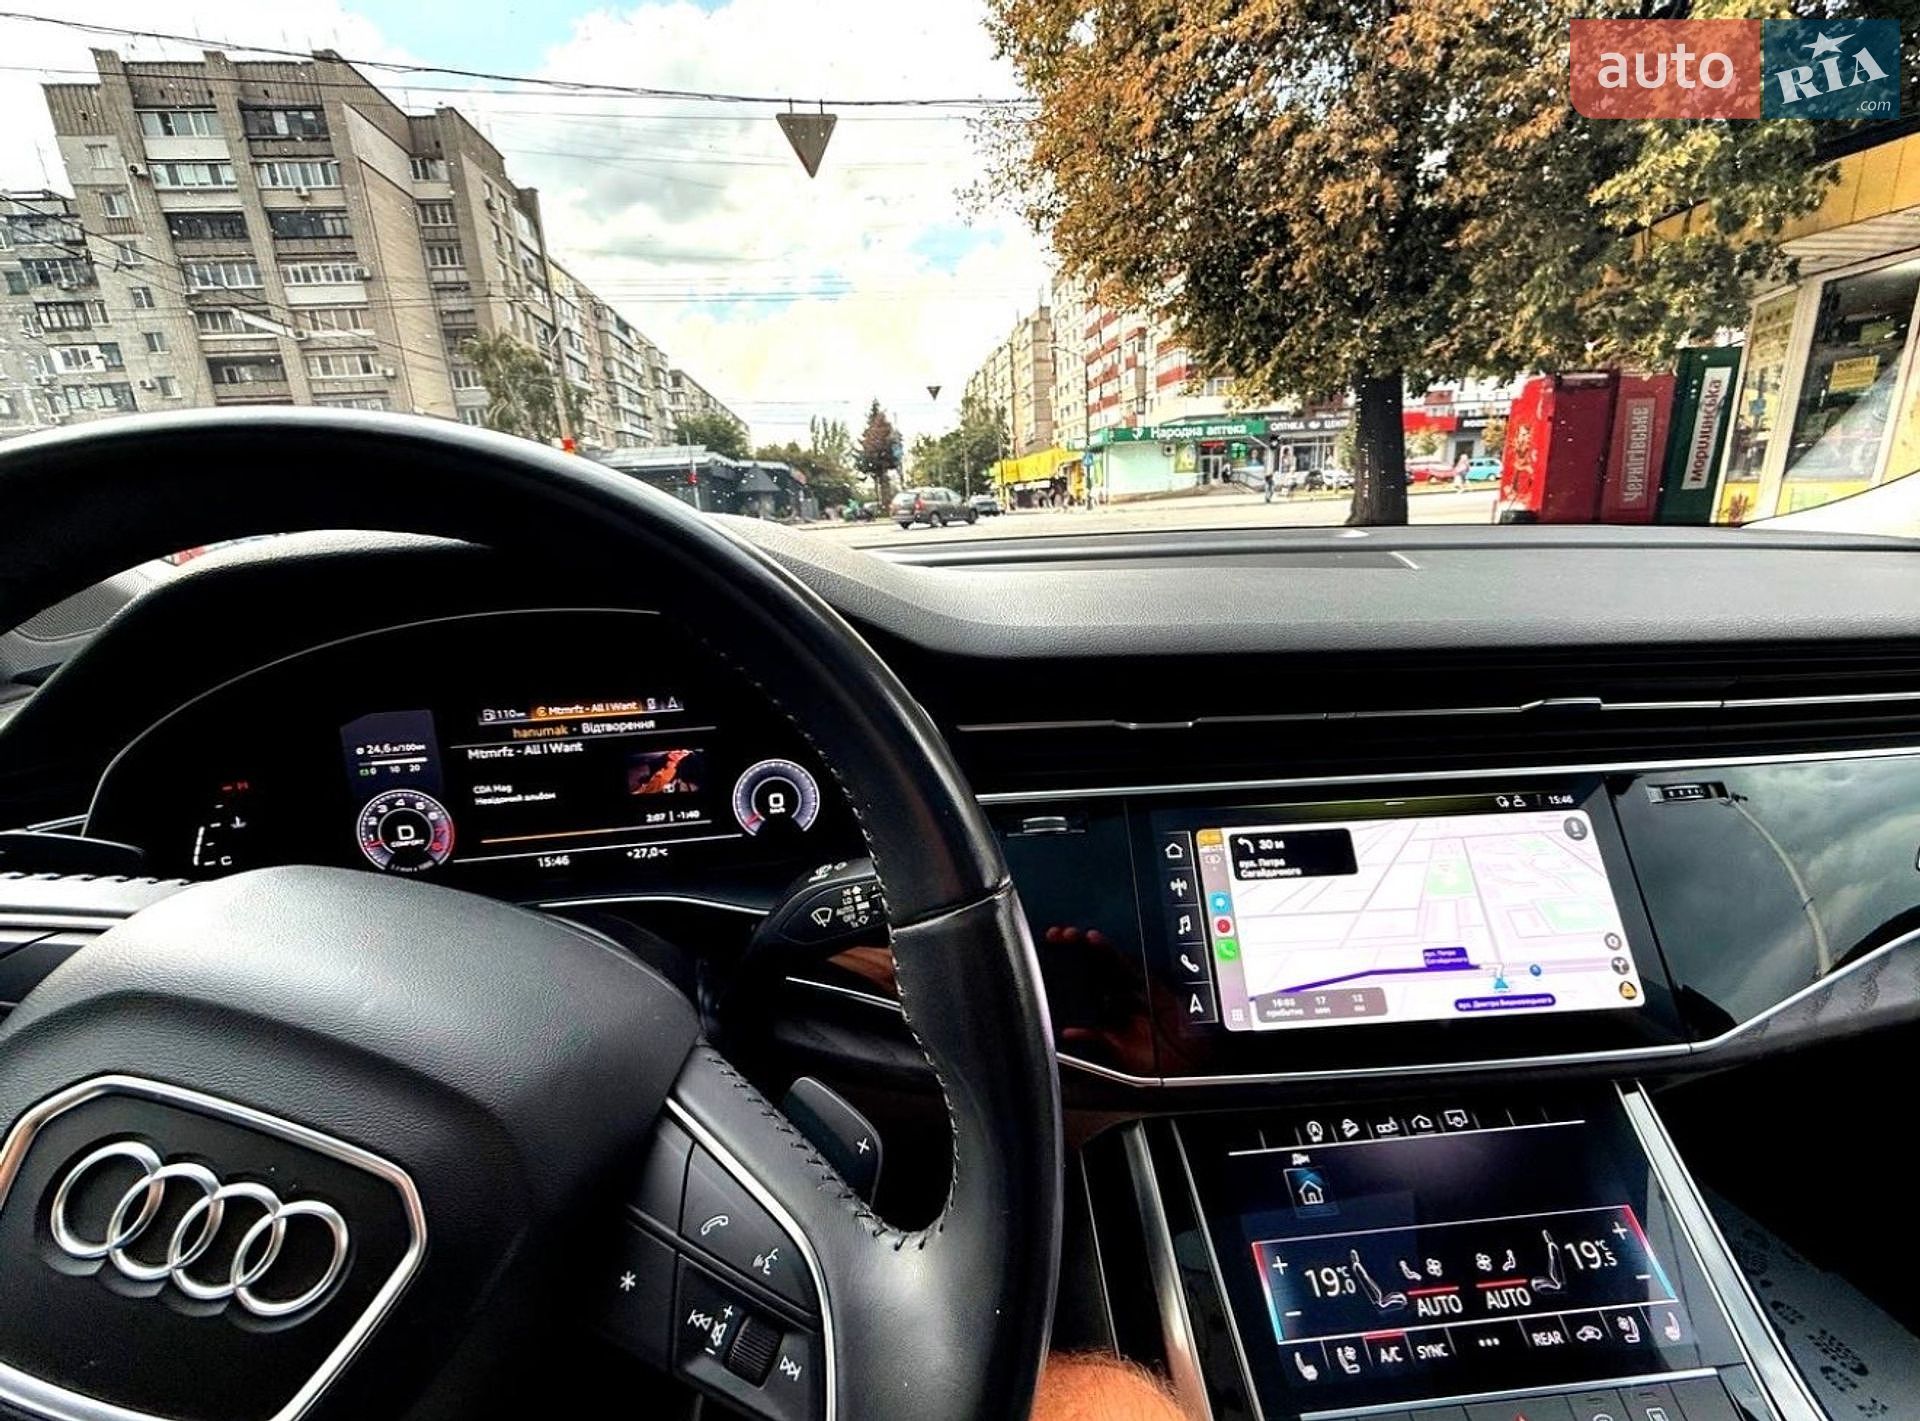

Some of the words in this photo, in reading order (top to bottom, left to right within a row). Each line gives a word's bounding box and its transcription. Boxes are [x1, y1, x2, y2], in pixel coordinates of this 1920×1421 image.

[1150, 427, 1203, 440] Народна
[1206, 424, 1247, 436] аптека
[611, 700, 639, 712] Want
[512, 724, 569, 739] hanumak
[581, 719, 656, 736] Відтворення
[551, 741, 584, 754] Want
[537, 855, 571, 868] 15:46
[1417, 1294, 1463, 1317] AUTO
[1486, 1287, 1532, 1310] AUTO
[1532, 1331, 1565, 1347] REAR
[1380, 1346, 1403, 1363] A/C
[1416, 1343, 1449, 1360] SYNC
